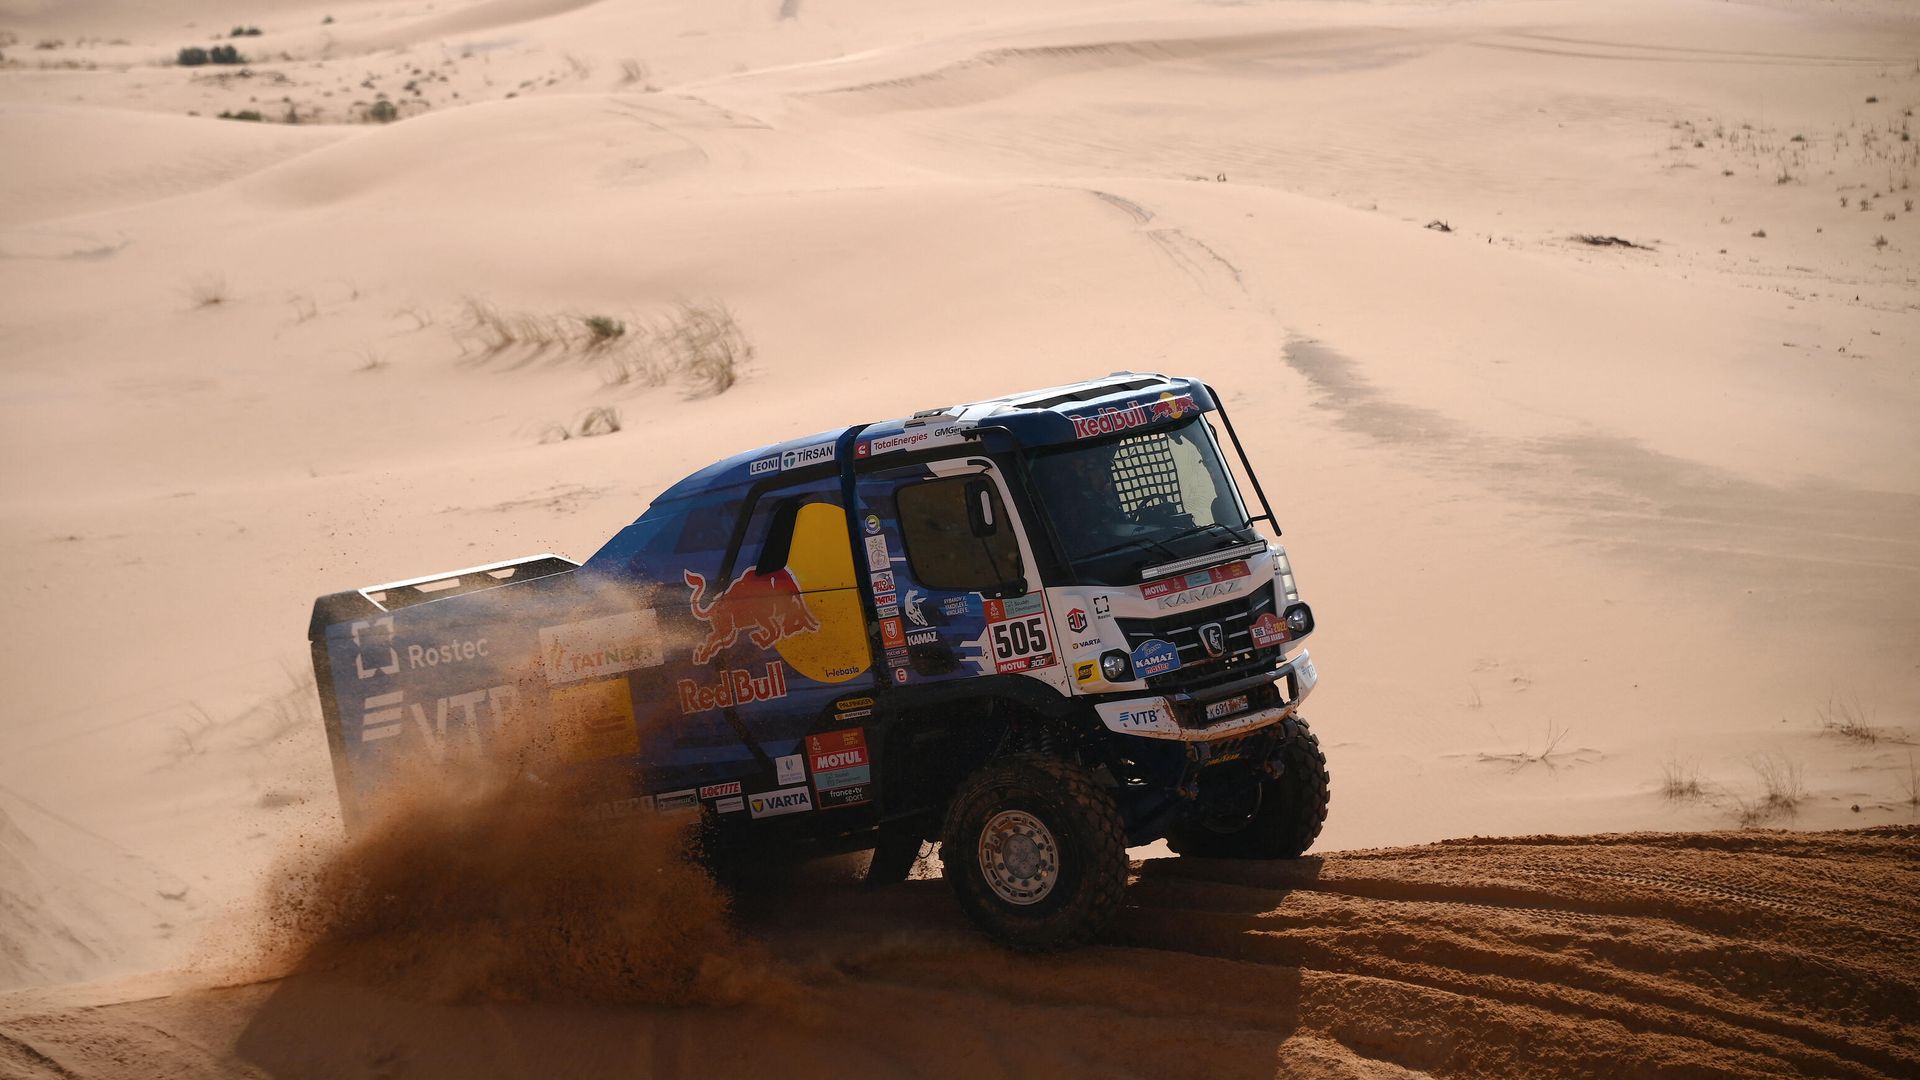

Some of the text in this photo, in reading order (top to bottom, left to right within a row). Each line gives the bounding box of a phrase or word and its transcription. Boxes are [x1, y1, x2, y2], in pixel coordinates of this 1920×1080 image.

[874, 432, 928, 451] TotalEnergies
[751, 459, 778, 473] LEONI
[1144, 583, 1168, 597] MOTUL
[1158, 579, 1242, 610] KAMAZ
[1273, 621, 1287, 633] 2022
[906, 631, 938, 647] KAMAZ
[993, 617, 1047, 659] 505
[1079, 638, 1101, 648] VARTA
[408, 637, 489, 670] Rostec
[1136, 652, 1174, 668] KAMAZ
[825, 666, 860, 678] Webasto
[1000, 658, 1046, 672] MOTUL 300
[1130, 709, 1157, 726] VTB
[817, 750, 862, 769] MOTUL
[702, 785, 740, 798] LOCTITE
[765, 792, 809, 809] VARTA
